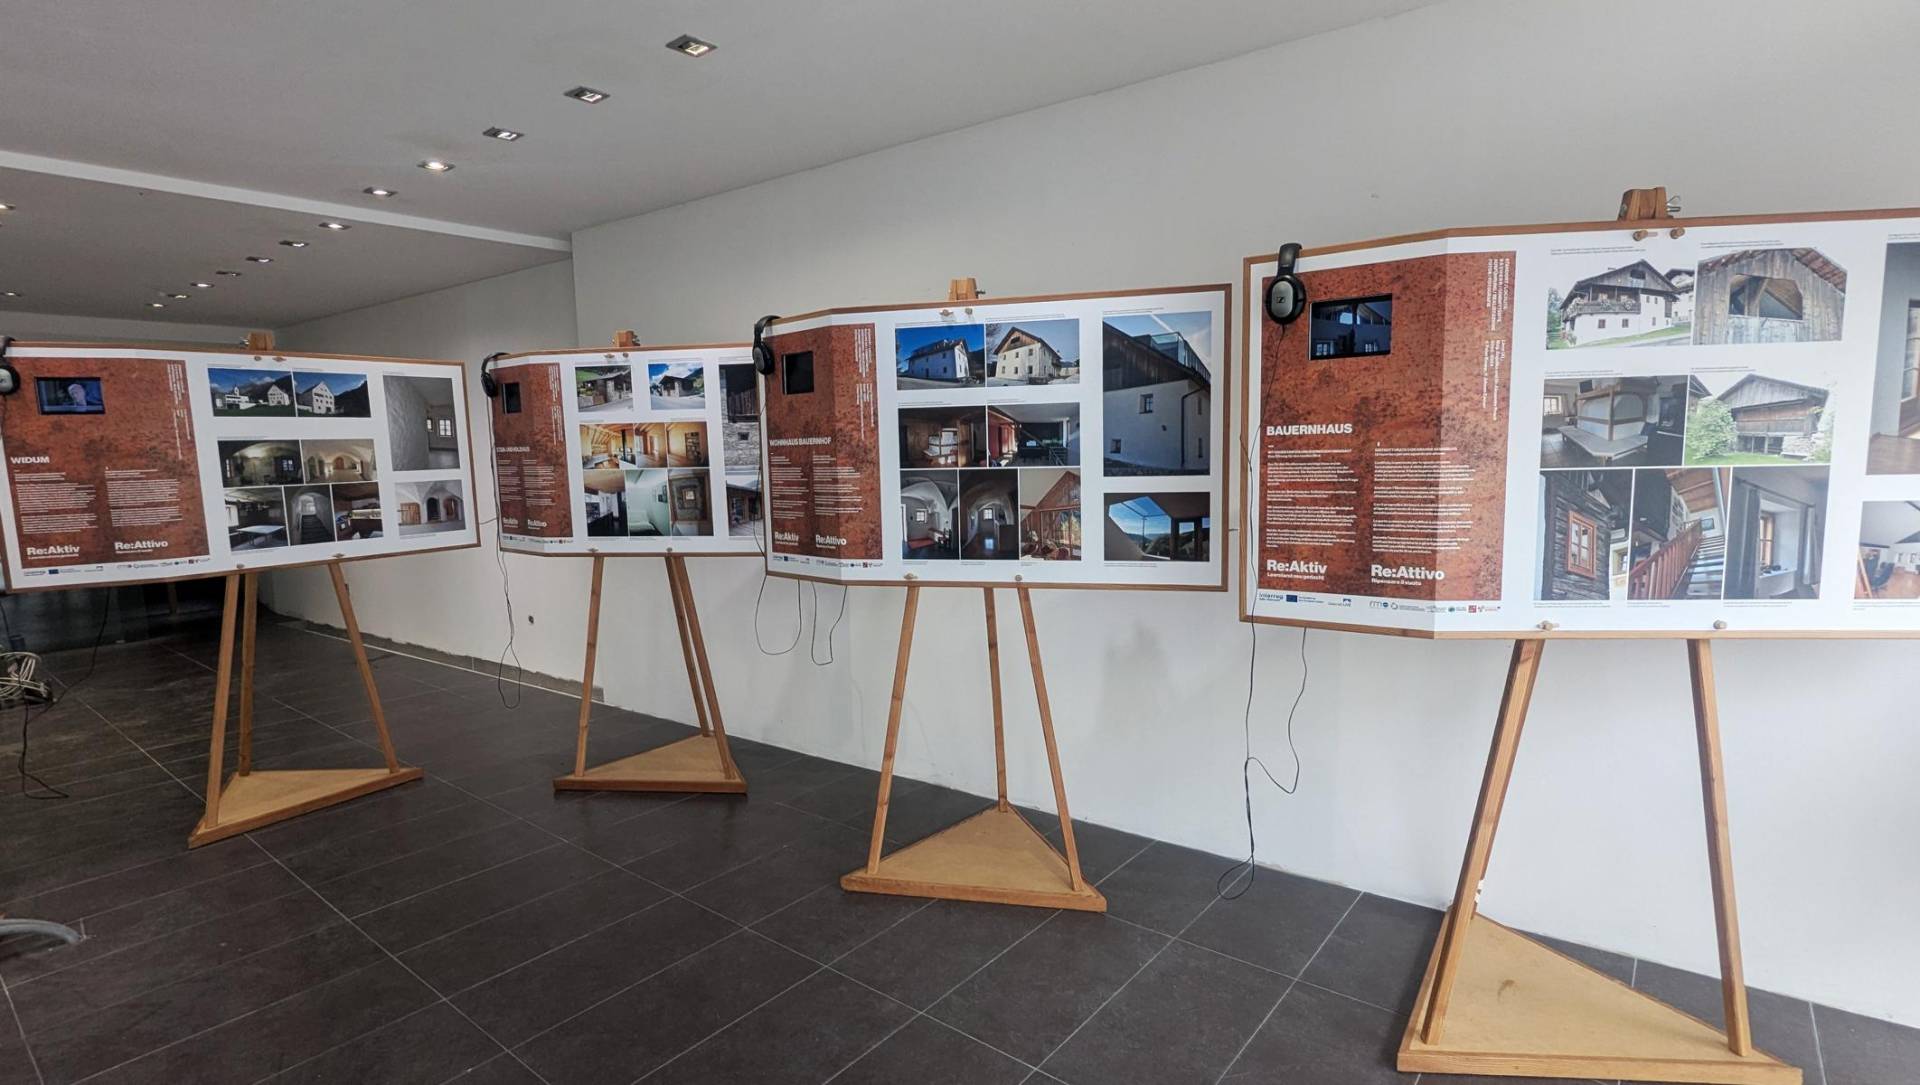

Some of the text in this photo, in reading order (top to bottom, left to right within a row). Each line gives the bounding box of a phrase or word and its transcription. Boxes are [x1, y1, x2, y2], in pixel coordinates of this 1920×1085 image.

[1266, 423, 1353, 436] BAUERNHAUS
[799, 436, 832, 446] BAUERNHOF
[10, 456, 50, 464] WIDUM
[27, 545, 80, 556] Re:Aktiv
[114, 540, 169, 550] Re:Attivo
[1266, 559, 1328, 574] Re:Aktiv
[1371, 564, 1445, 580] Re:Attivo
